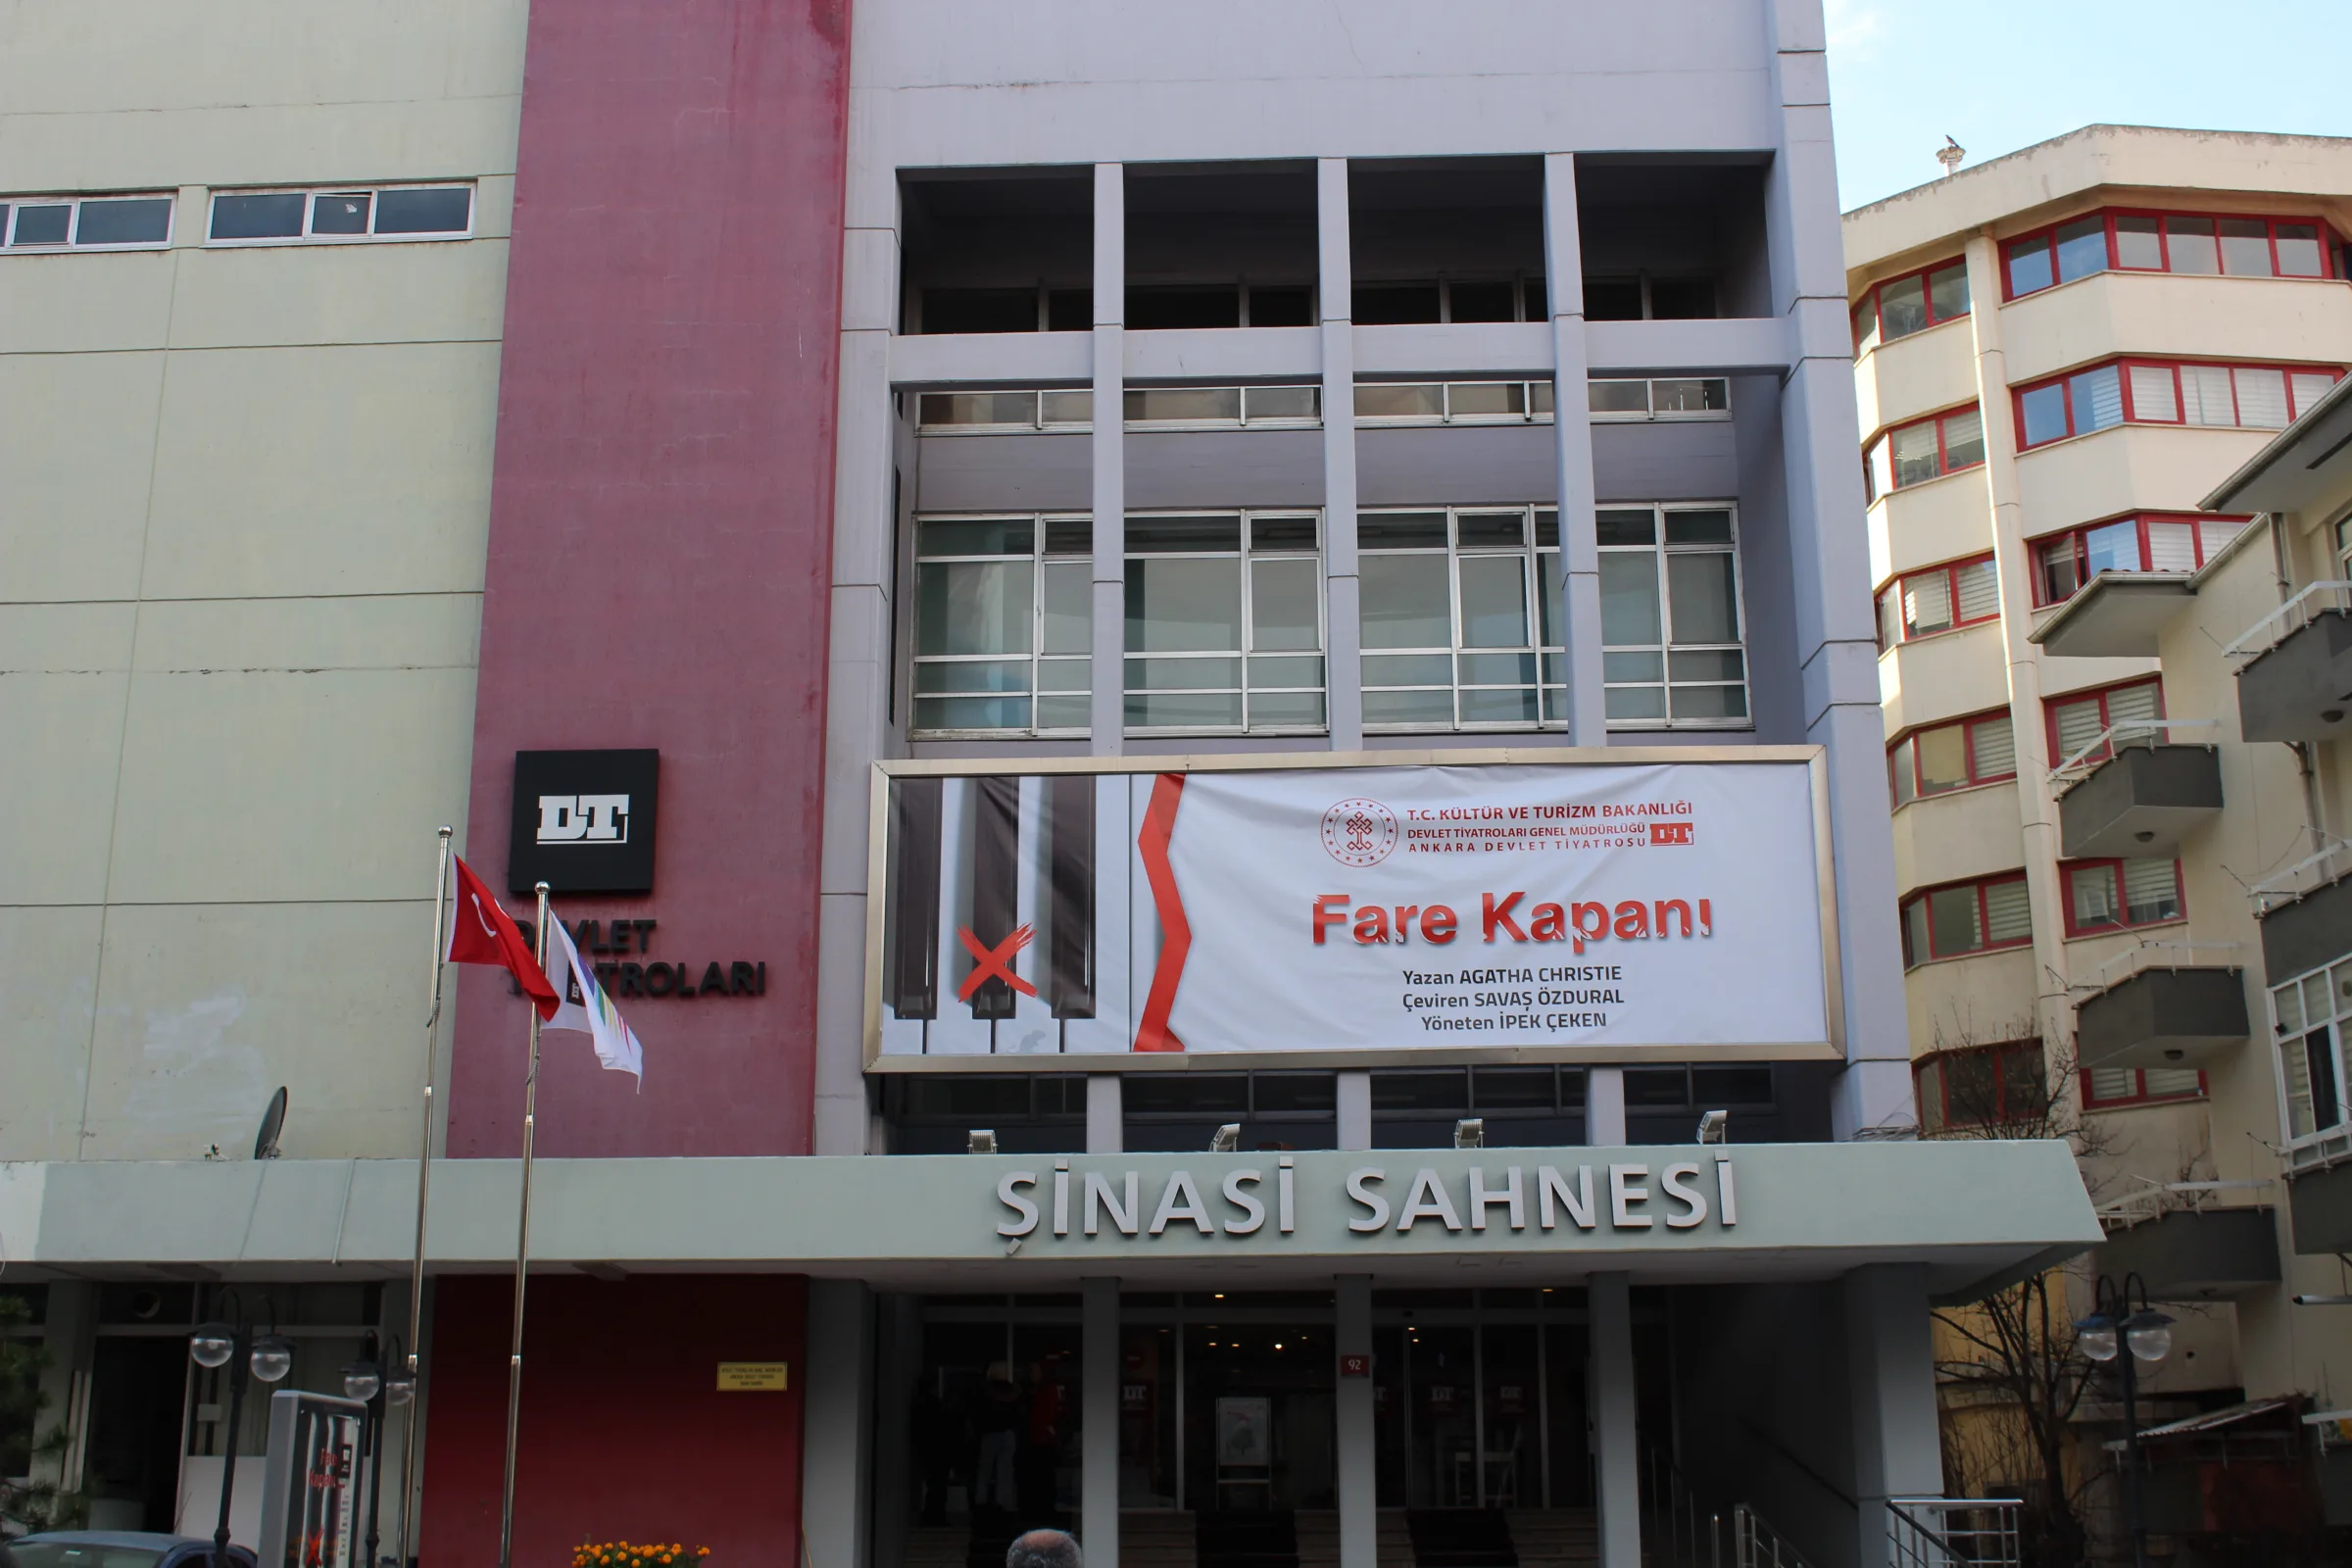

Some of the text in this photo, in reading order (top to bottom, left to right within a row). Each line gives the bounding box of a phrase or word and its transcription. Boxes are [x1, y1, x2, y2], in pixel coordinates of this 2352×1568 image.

[536, 794, 630, 845] DT
[1407, 800, 1692, 821] T.C. KÜLTÜR VE TURİZM BAKANLIĞI
[1407, 822, 1645, 839] DEVLET TİYATROLARI GENEL MÜDÜRLÜĞÜ
[1649, 822, 1694, 847] DT
[1408, 837, 1645, 853] ANKARA DEVLET TİYATROSU
[1312, 891, 1712, 955] Fare Kapanı
[512, 919, 656, 954] DVLET
[1402, 965, 1622, 986] Yazan AGATHA CHRISTIE
[1402, 989, 1625, 1010] Çeviren SAVAŞ ÖZDURAL
[1421, 1010, 1607, 1032] Yöneten İPEK ÇEKEN
[996, 1150, 1737, 1255] ŞİNASİ SAHNESİ
[1348, 1358, 1361, 1370] 92
